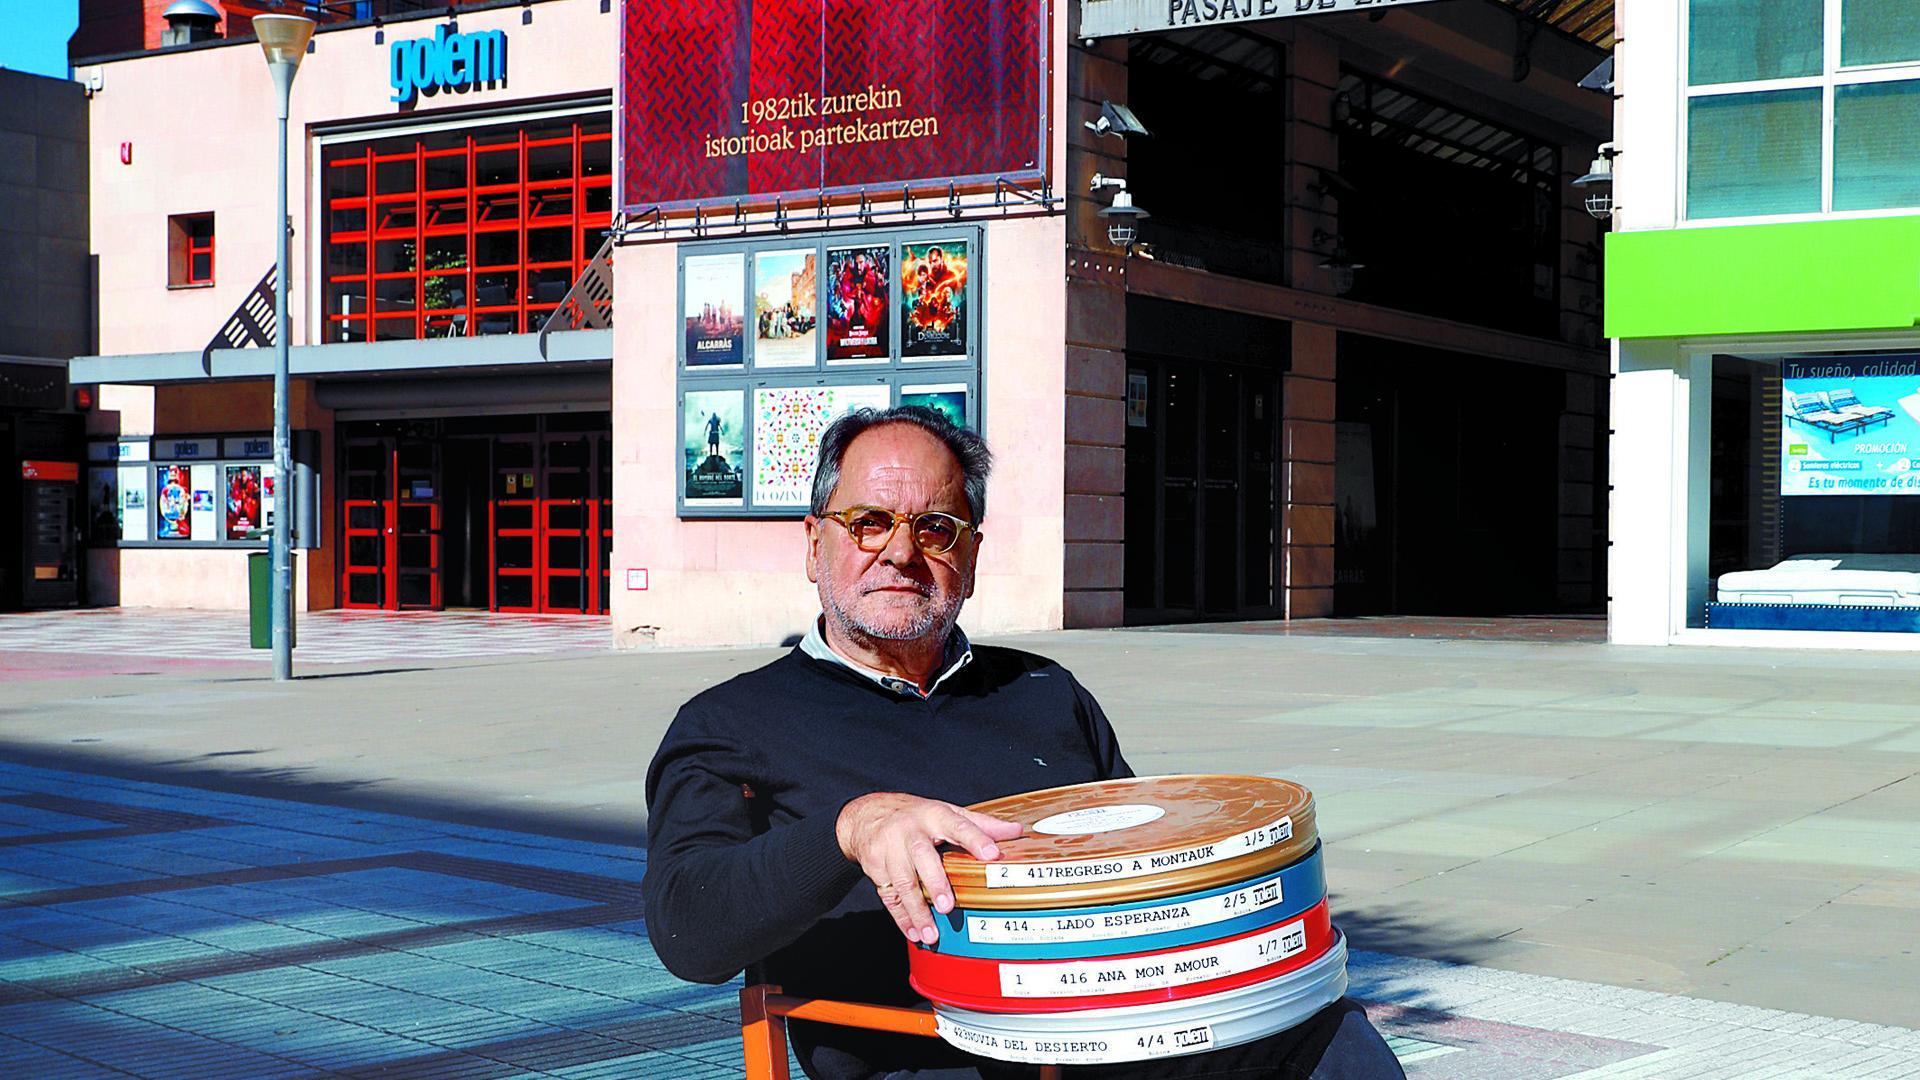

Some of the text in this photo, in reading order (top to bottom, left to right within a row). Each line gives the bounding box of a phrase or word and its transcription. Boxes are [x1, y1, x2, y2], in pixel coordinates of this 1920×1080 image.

[1168, 0, 1278, 26] PASAJE
[390, 24, 505, 102] golem
[741, 84, 902, 124] 1982tik zurekin
[705, 116, 939, 158] istorioak partekartzen
[1789, 359, 1917, 381] Tu sueño, calidad
[1808, 477, 1820, 488] Es
[1823, 478, 1835, 488] tu
[1838, 478, 1887, 488] momento
[1890, 477, 1904, 488] de
[1000, 867, 1009, 878] 2
[1132, 860, 1143, 871] A
[1151, 845, 1215, 868] MONTAUK
[1245, 833, 1265, 847] 1/5
[980, 919, 988, 931] 2
[1104, 906, 1190, 927] ESPERANZA
[1223, 893, 1247, 909] 2/5
[1016, 940, 1278, 985] 1 416 ANA MON AMOUR 1/7
[1004, 1039, 1028, 1051] DEL
[1035, 1041, 1108, 1053] DESIERTO
[1137, 1034, 1165, 1049] 4/4
